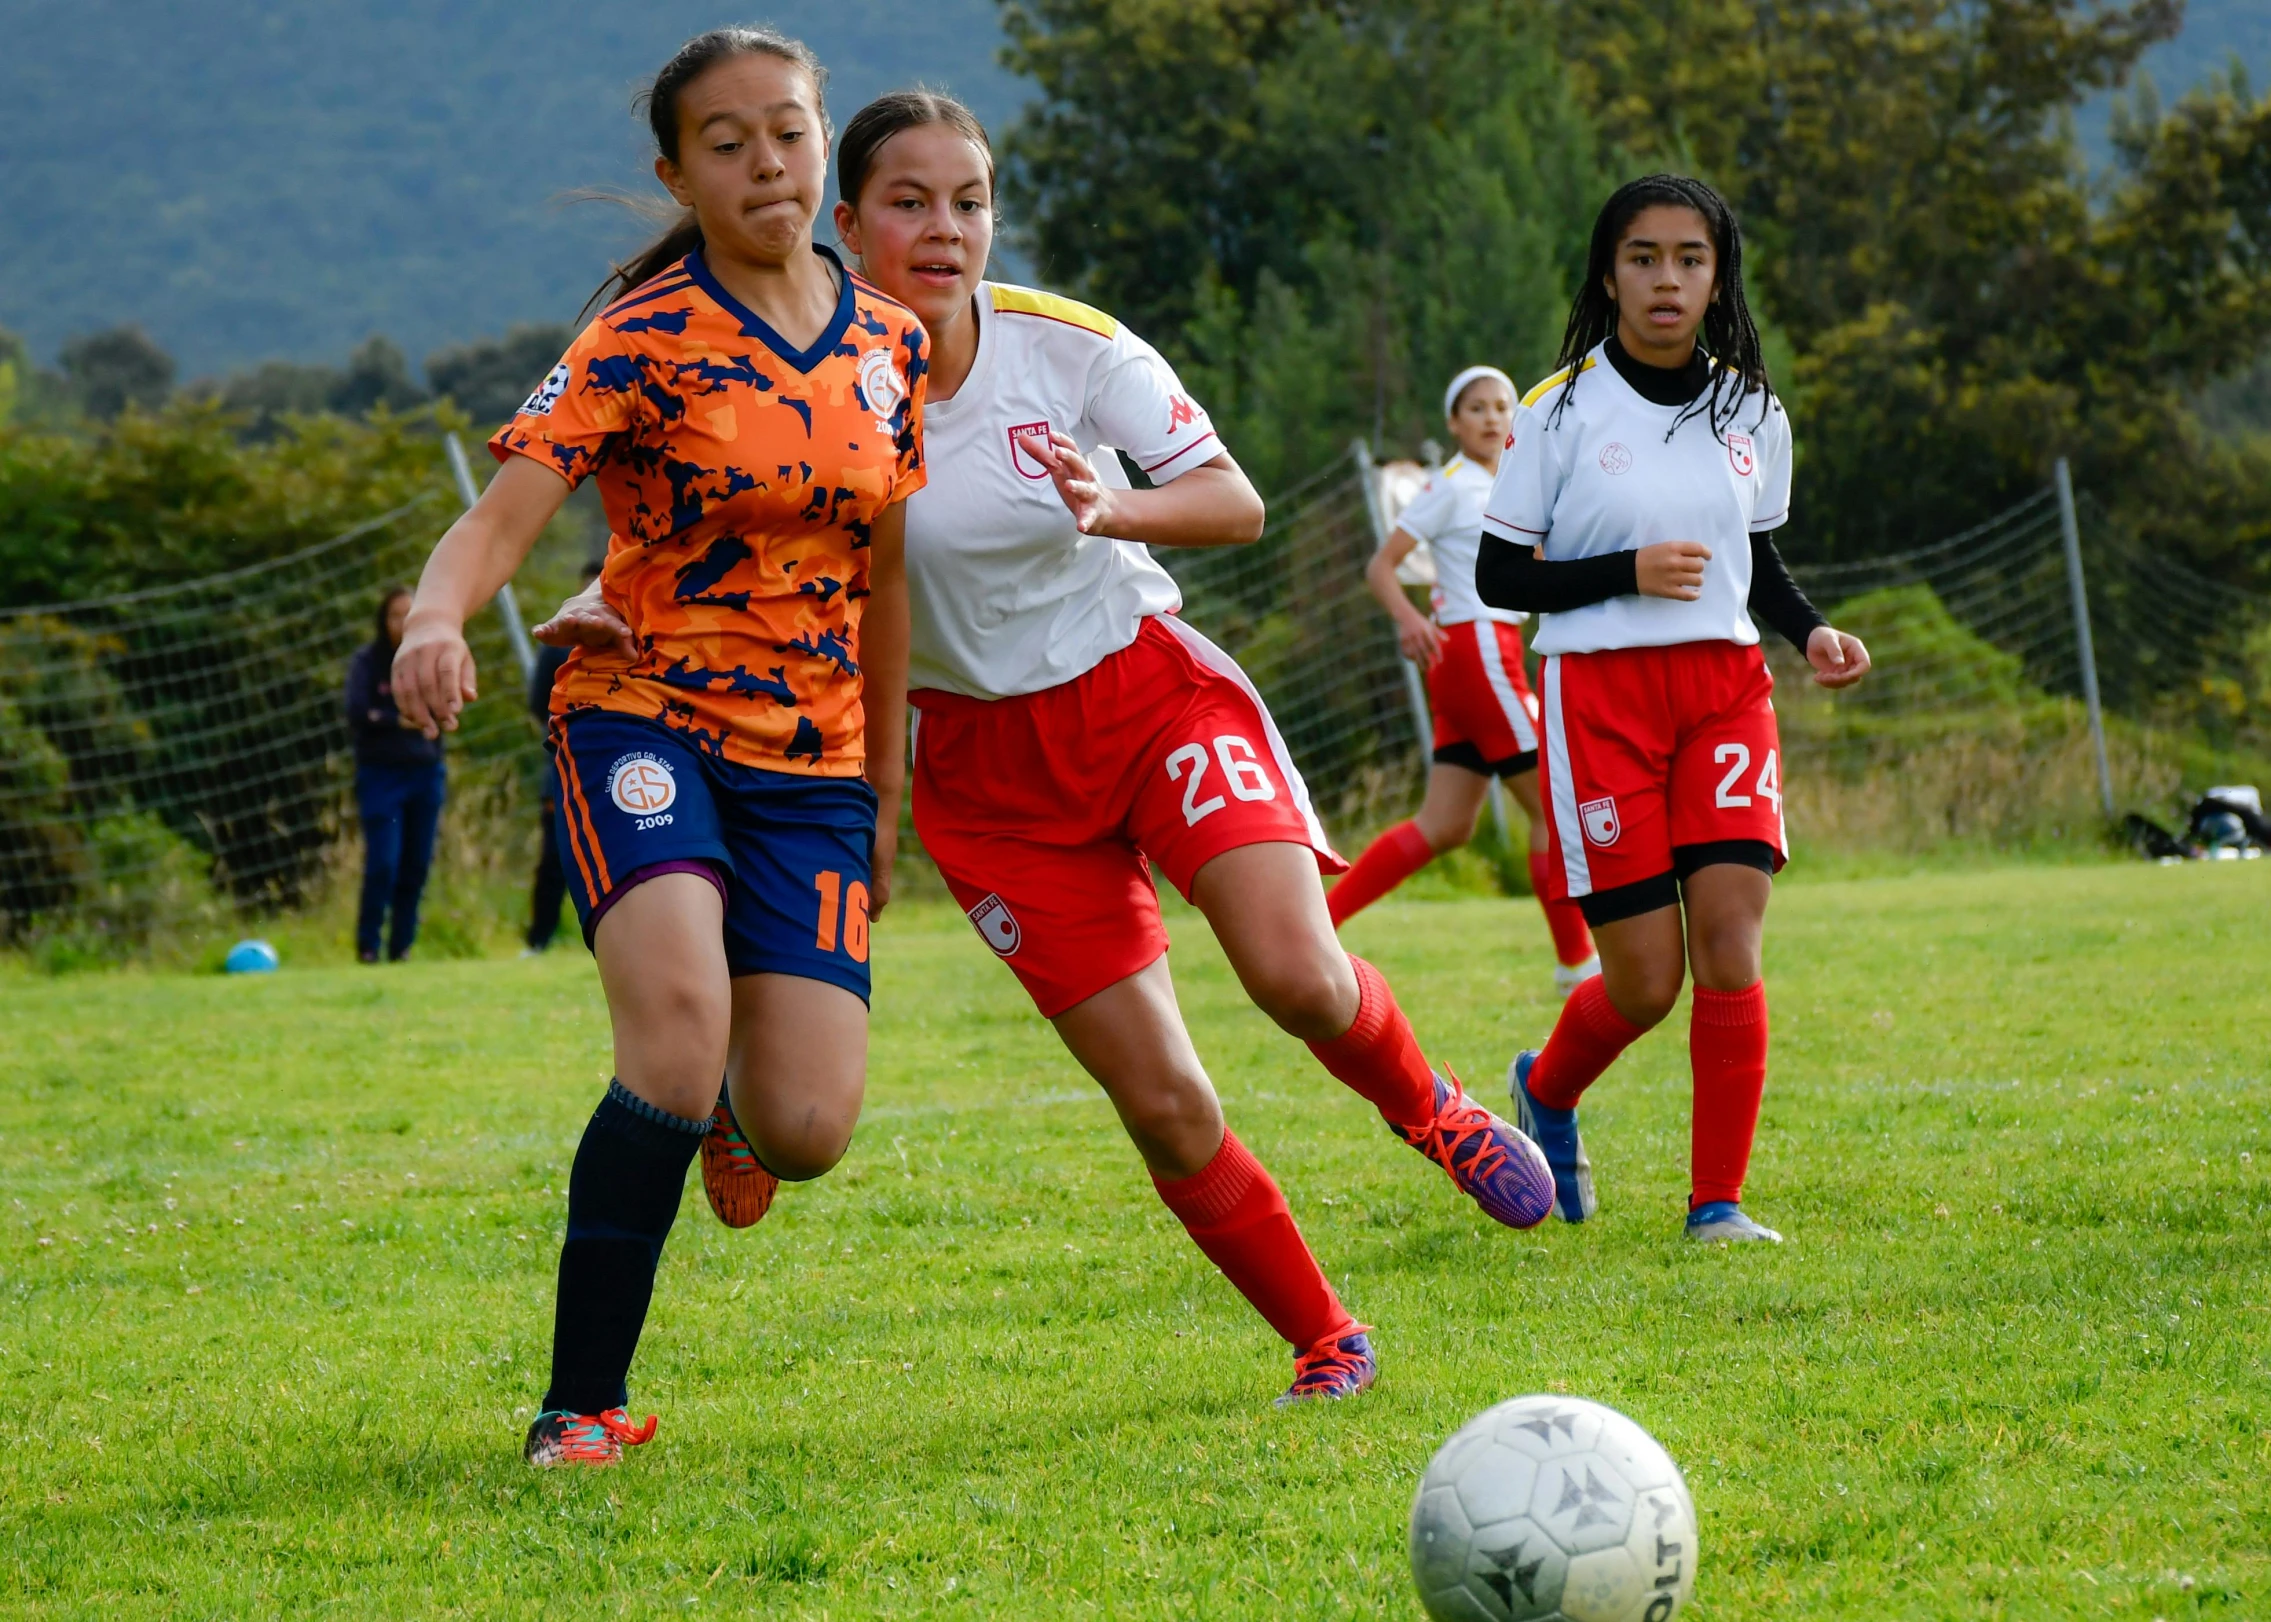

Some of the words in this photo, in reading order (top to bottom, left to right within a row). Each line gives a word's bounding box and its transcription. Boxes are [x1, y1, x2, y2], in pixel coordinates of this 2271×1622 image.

[1012, 427, 1037, 438] SANTA
[1038, 425, 1047, 434] FE
[604, 775, 614, 794] CLUB
[609, 751, 642, 775] DEPORTIVO
[643, 751, 657, 762] GOL
[658, 757, 675, 773] STAR
[1165, 735, 1276, 827] 26
[1714, 743, 1780, 815] 24
[635, 814, 675, 831] 2009
[1584, 803, 1602, 814] SANTA
[1602, 800, 1611, 809] FE
[815, 870, 869, 963] 16
[972, 903, 991, 921] SANTA
[989, 896, 999, 907] FE
